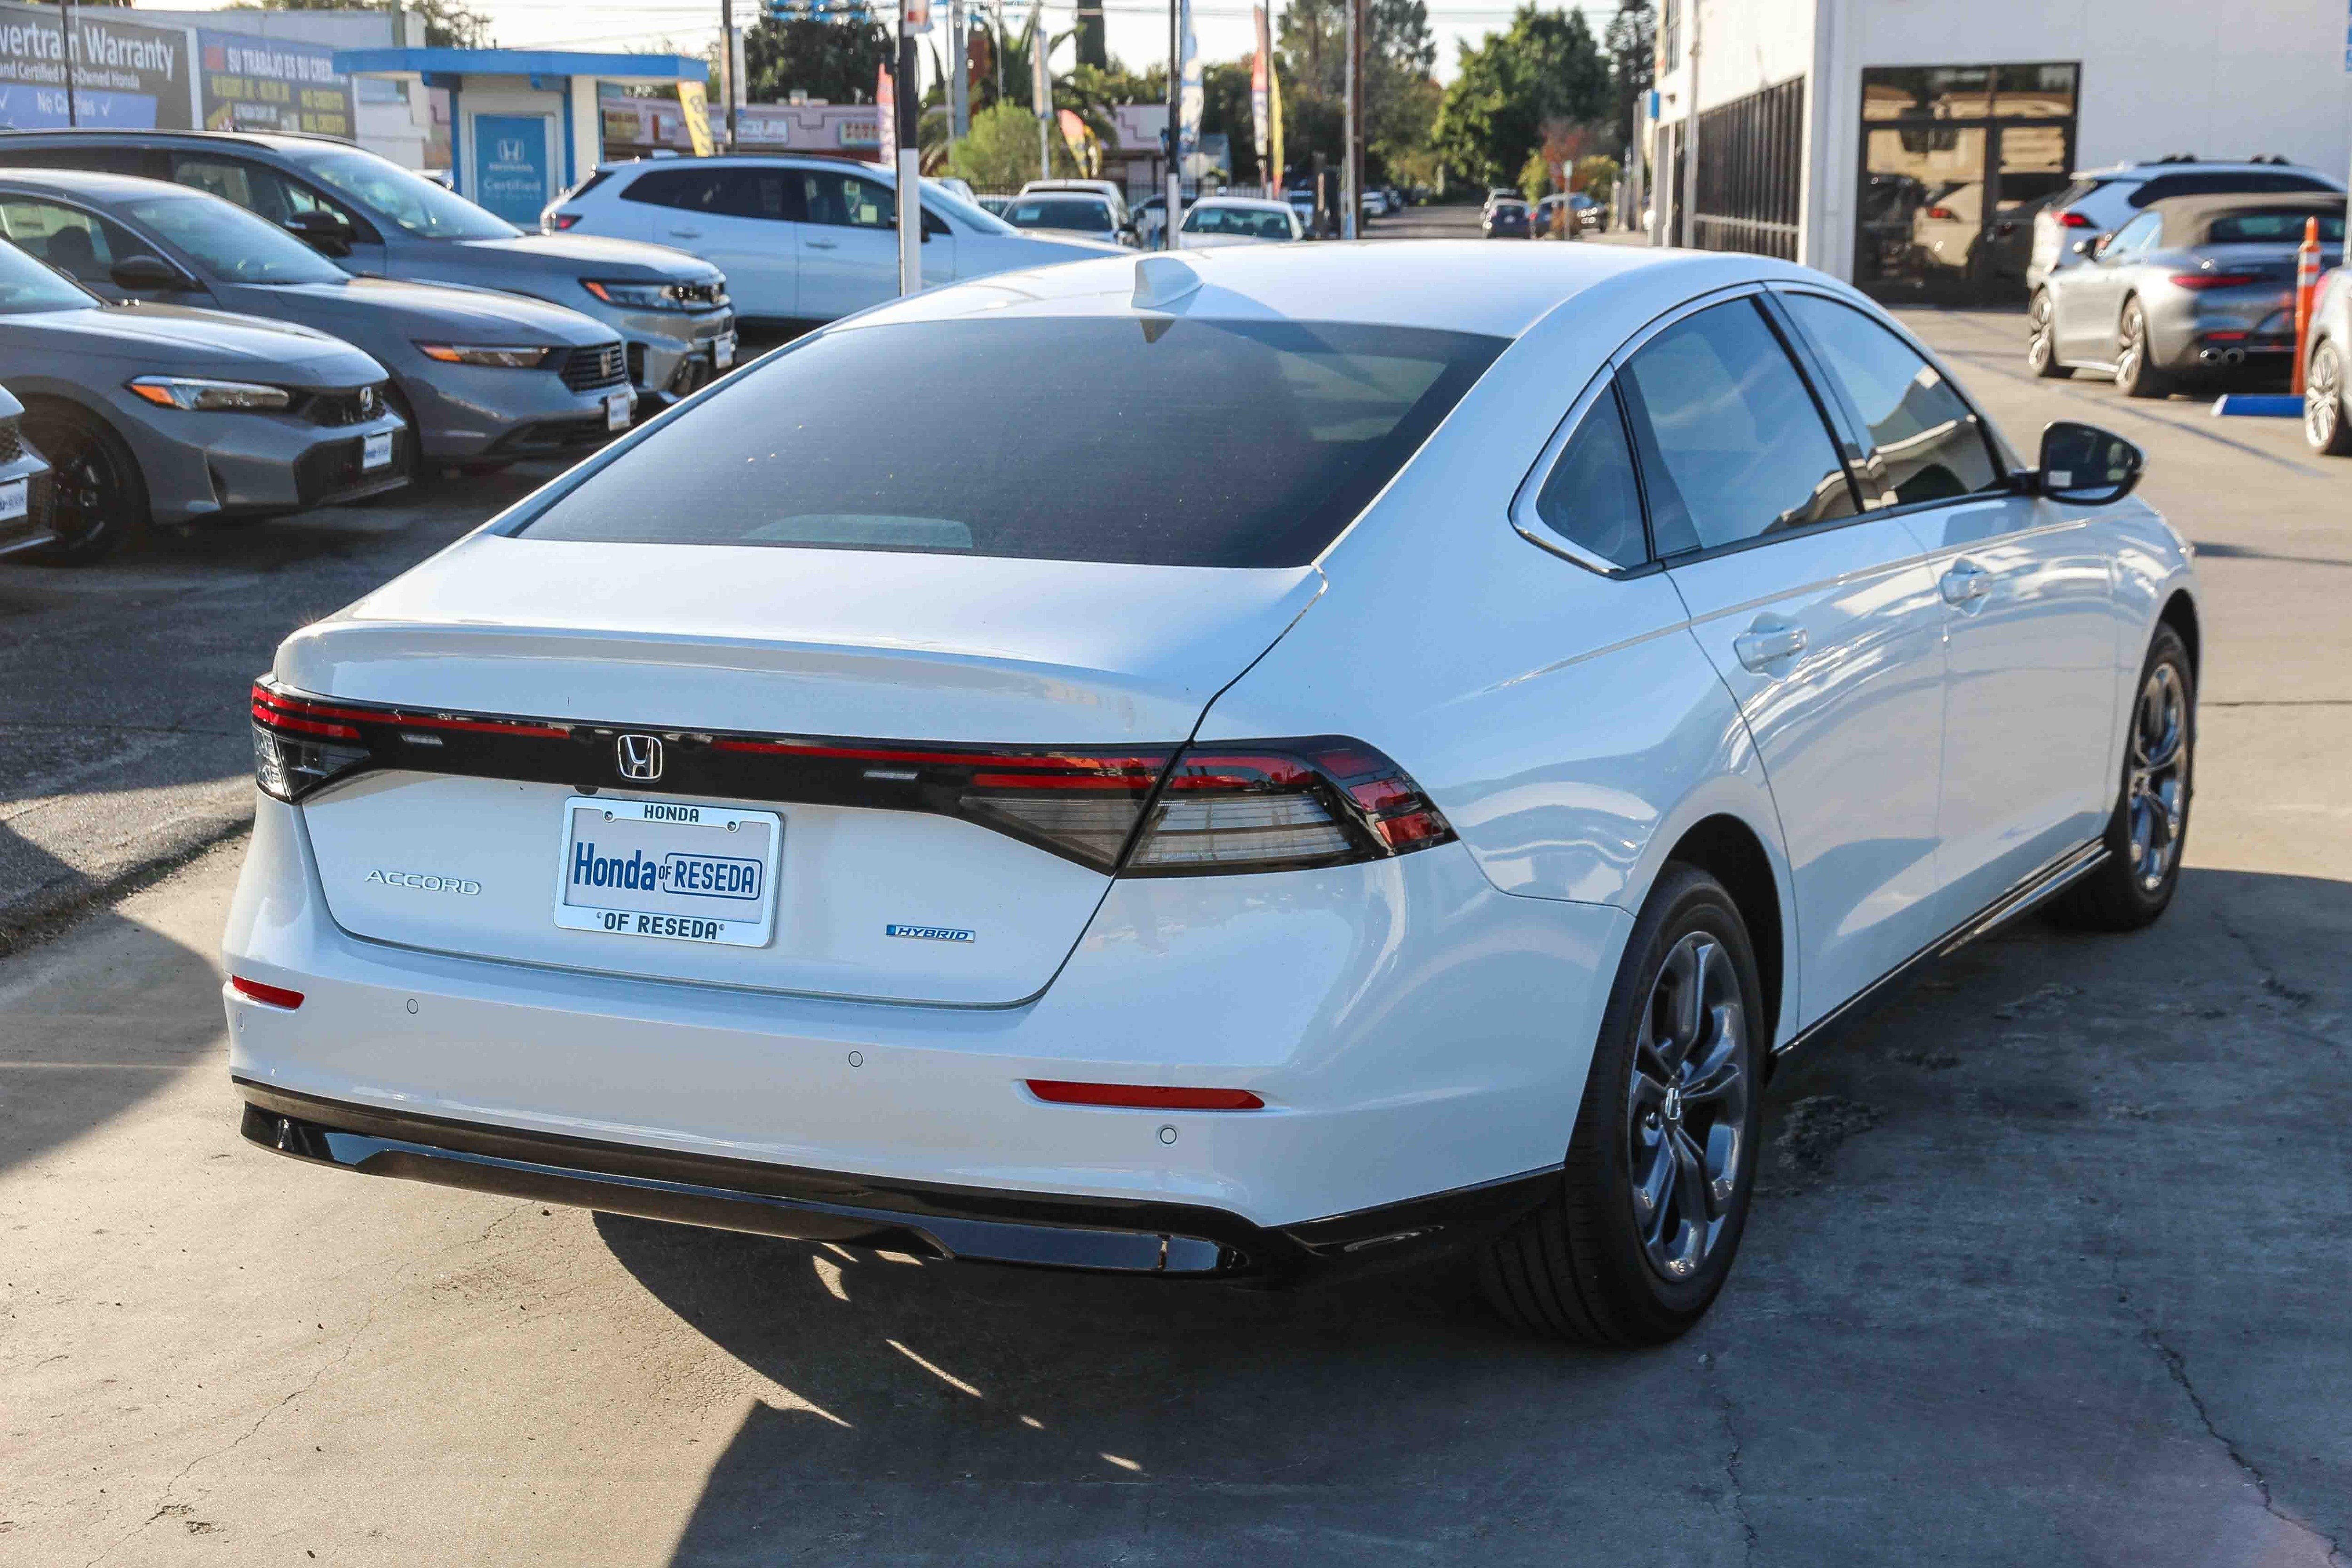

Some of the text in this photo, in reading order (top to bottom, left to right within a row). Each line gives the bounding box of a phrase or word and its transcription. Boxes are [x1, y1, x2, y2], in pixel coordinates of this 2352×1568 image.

[84, 25, 174, 82] Warranty
[227, 47, 241, 73] SU
[18, 60, 59, 84] Certified
[111, 70, 140, 89] Honda
[37, 90, 52, 114] No
[644, 804, 699, 823] HONDA
[573, 842, 755, 894] Honda OF RESEDA
[364, 869, 481, 895] ACCORD
[604, 912, 717, 940] OF RESEDA
[898, 927, 969, 940] HYBRID
